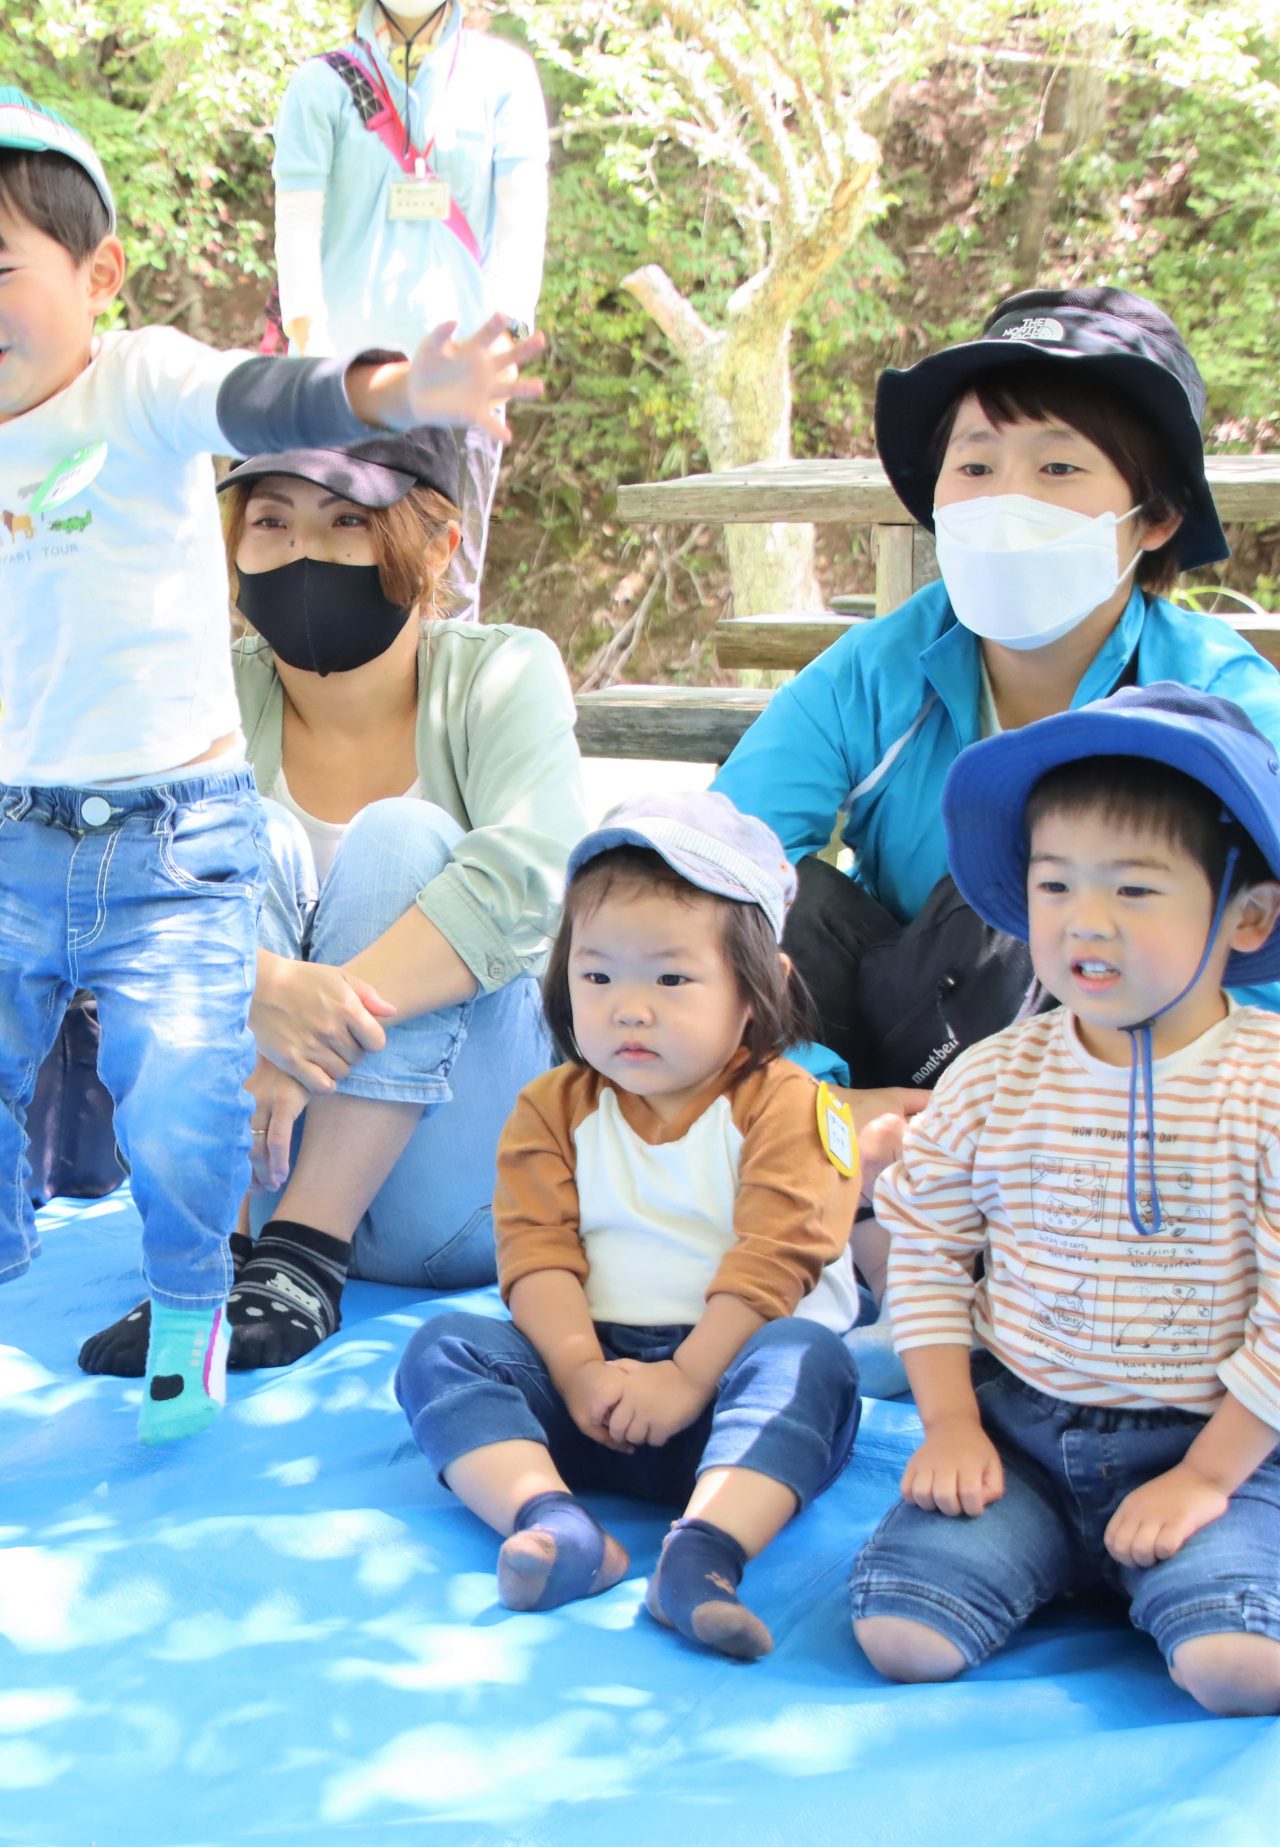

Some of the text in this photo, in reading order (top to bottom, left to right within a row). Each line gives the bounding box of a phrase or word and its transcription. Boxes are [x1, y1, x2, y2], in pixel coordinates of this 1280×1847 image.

[1022, 317, 1046, 327] THE
[42, 543, 78, 558] TOUR
[1072, 1126, 1092, 1137] HOW
[1096, 1127, 1107, 1138] TO
[1159, 1132, 1179, 1144] DAY
[1127, 1247, 1177, 1258] Studying
[1151, 1258, 1202, 1272] important
[1056, 1311, 1082, 1328] Honey
[1122, 1360, 1147, 1368] have
